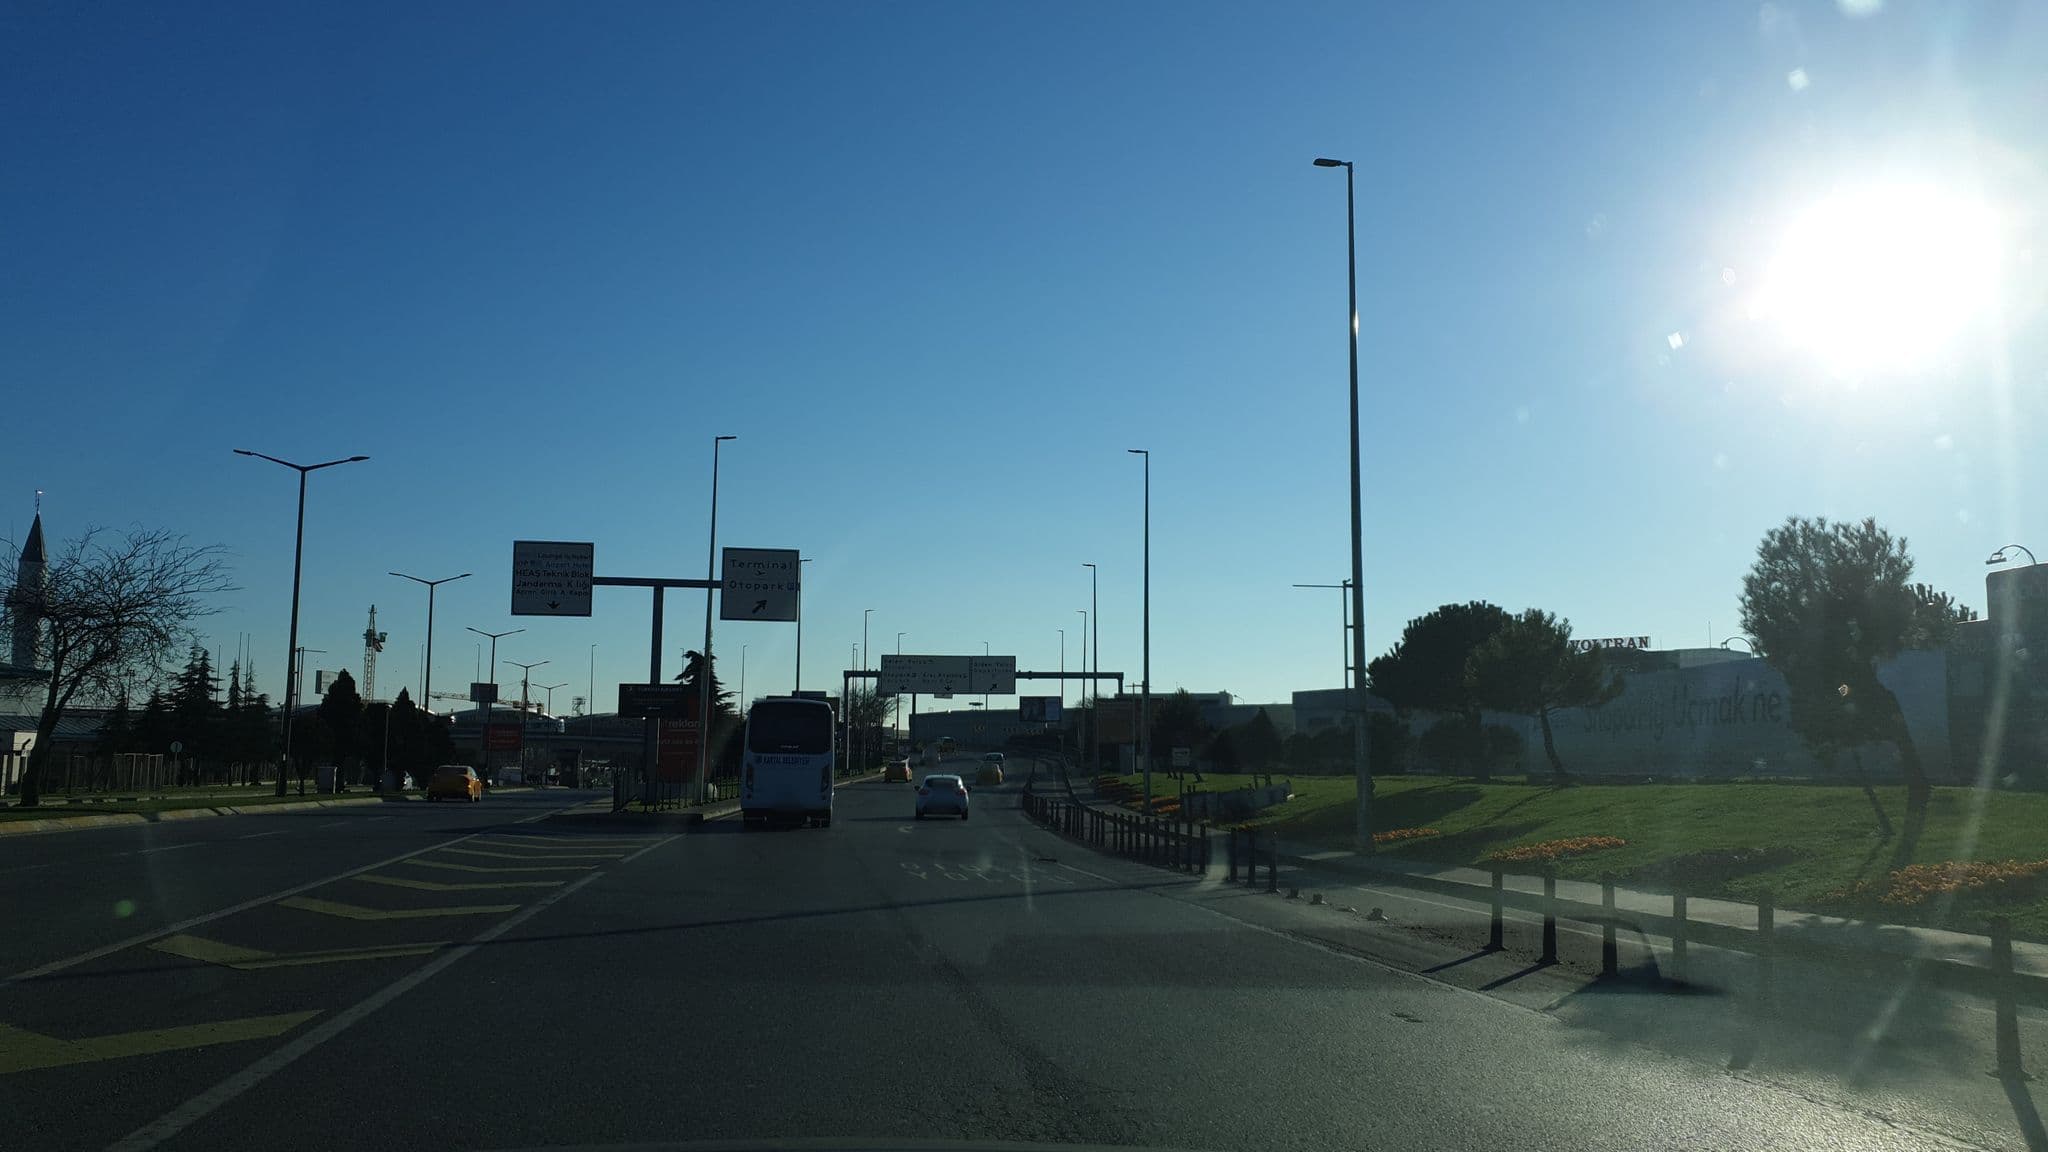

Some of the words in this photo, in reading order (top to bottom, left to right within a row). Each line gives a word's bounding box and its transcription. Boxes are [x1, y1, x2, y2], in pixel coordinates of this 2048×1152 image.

[730, 559, 793, 569] Terminal
[730, 580, 784, 590] Otopark
[1568, 636, 1650, 651] VOLTRAN
